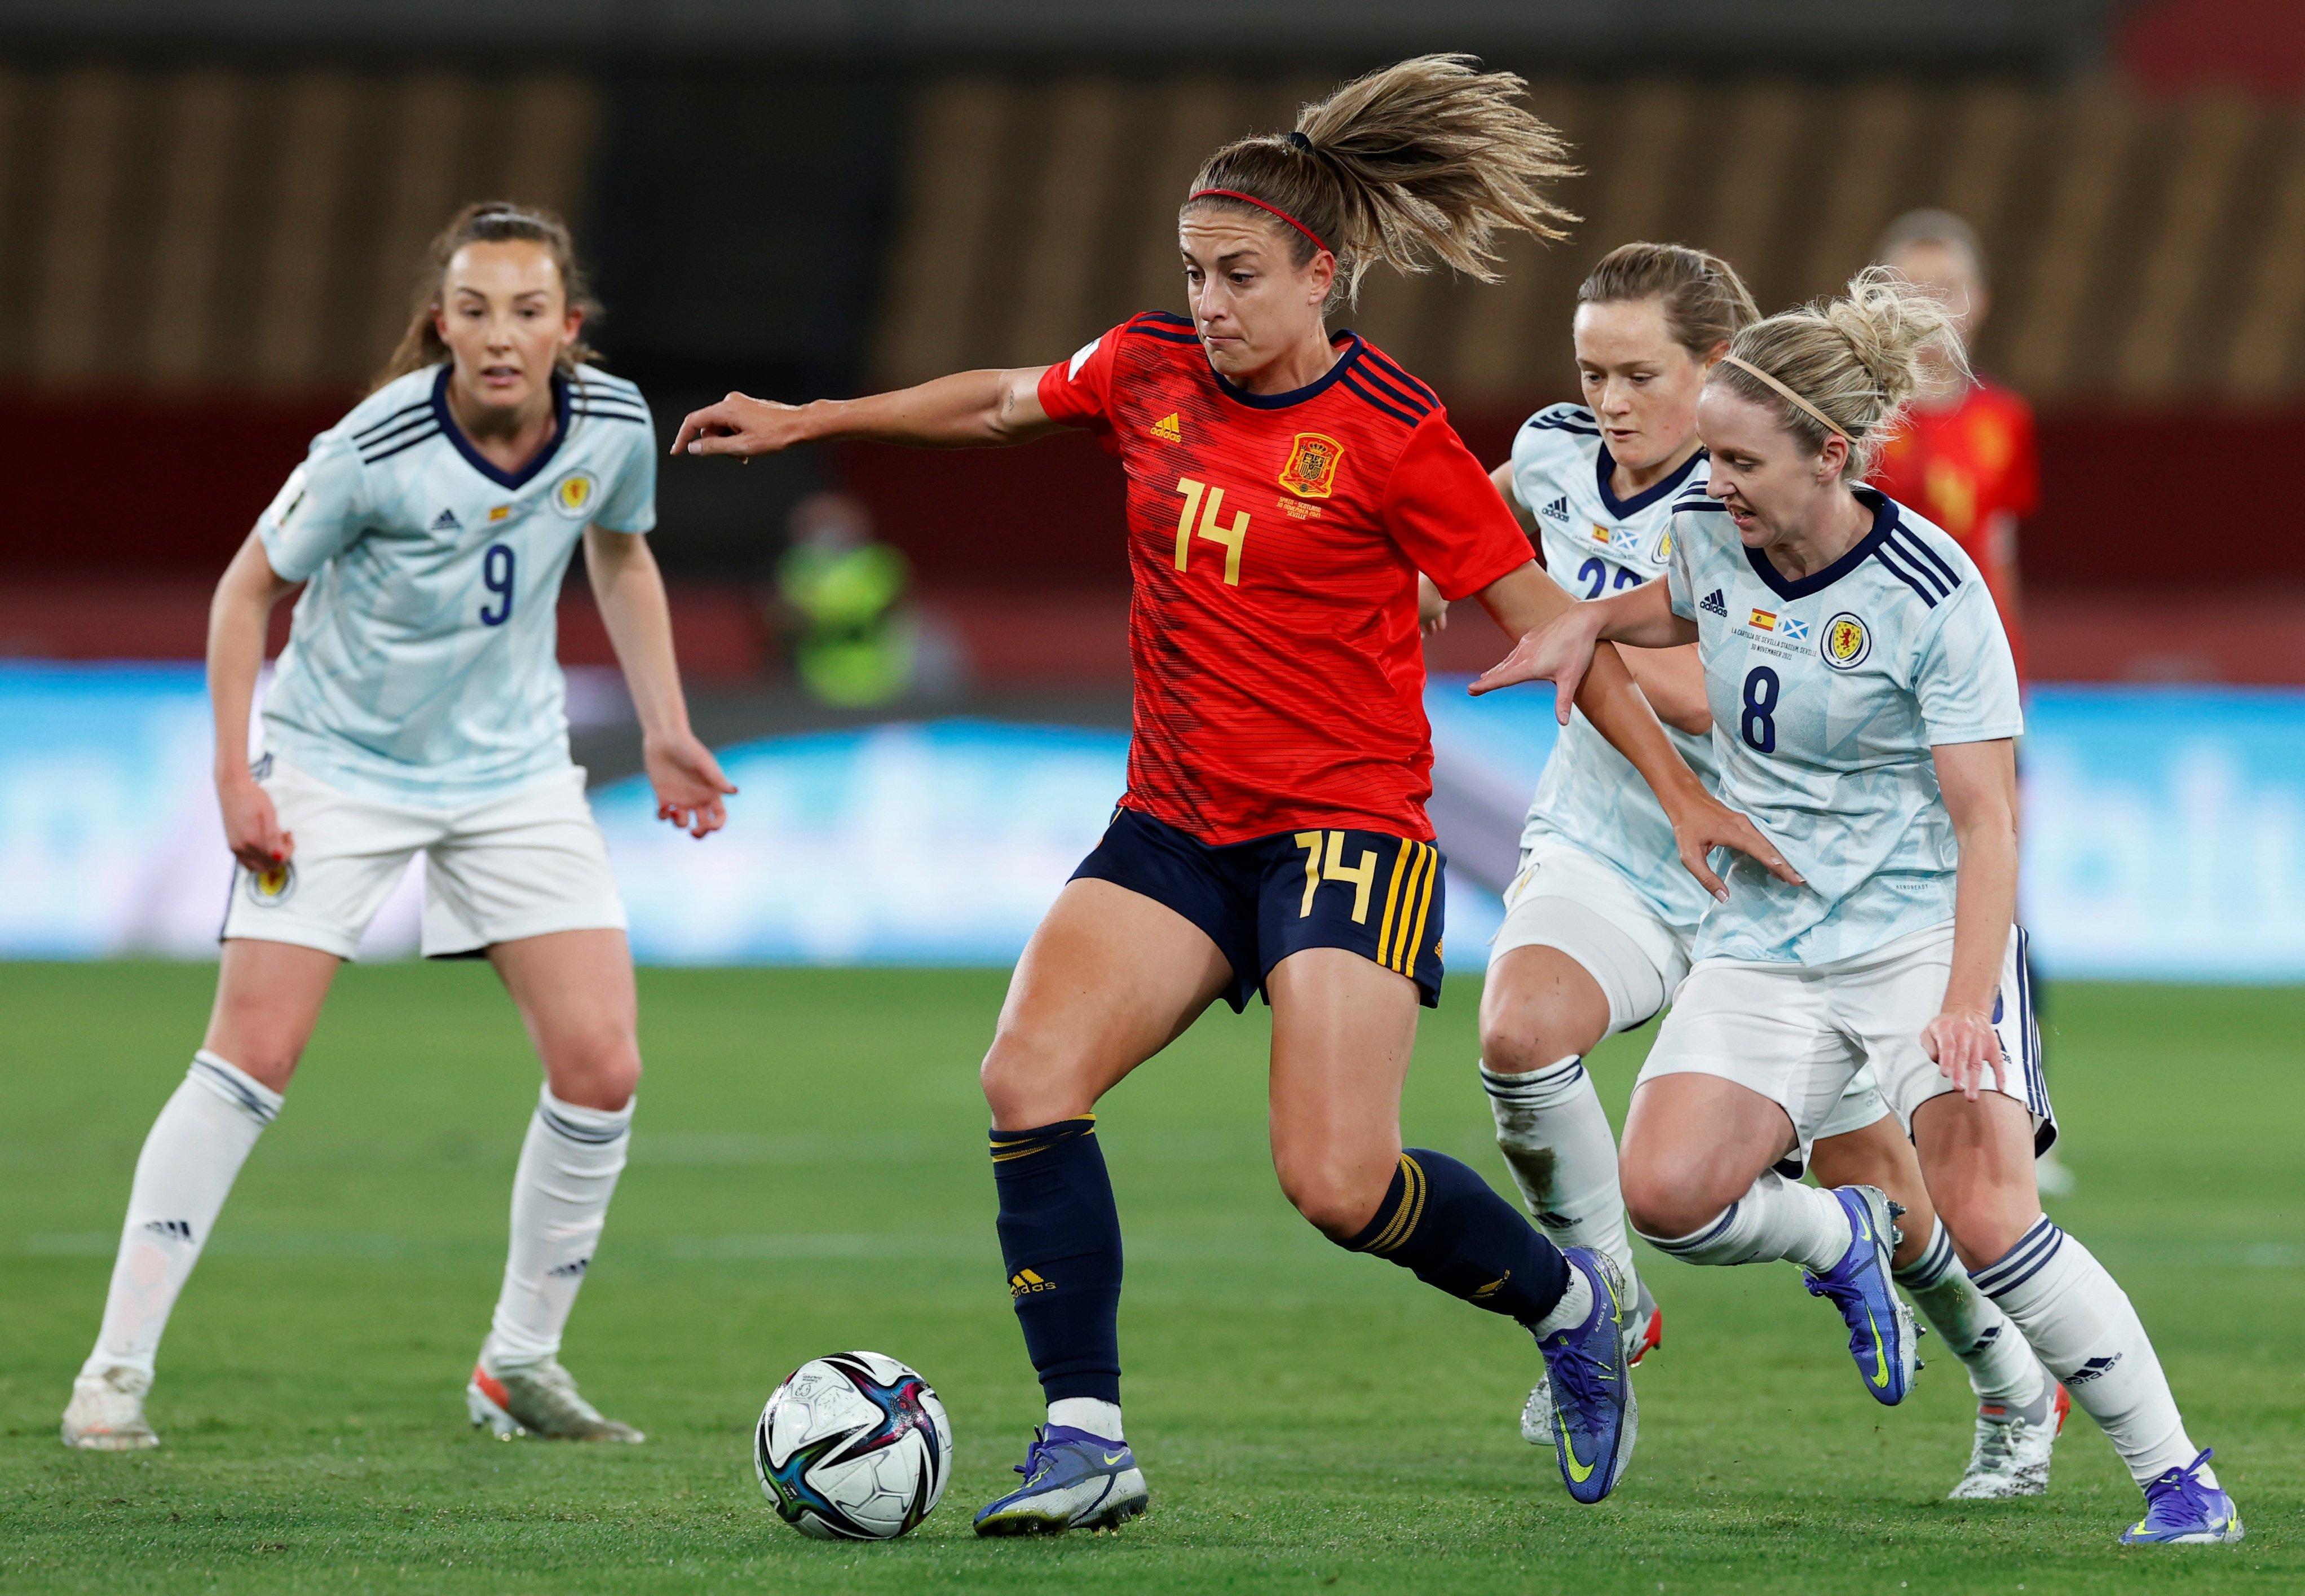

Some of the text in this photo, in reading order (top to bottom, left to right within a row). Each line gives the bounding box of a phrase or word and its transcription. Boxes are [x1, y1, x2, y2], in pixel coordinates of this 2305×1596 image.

[1150, 427, 1182, 443] adidas
[1278, 497, 1294, 505] SPAIN
[1297, 502, 1322, 512] SCOTLAND
[1283, 504, 1308, 515] NOVEMBER
[1286, 510, 1306, 520] SEVILLE
[1542, 507, 1569, 523] adidas
[1174, 477, 1251, 587] 14
[480, 545, 515, 626] 9
[1699, 601, 1728, 617] adidas
[1840, 617, 1861, 627] SCOTLAND
[1737, 629, 1754, 639] CARTUJA
[1761, 636, 1780, 647] SEVILLA
[1800, 647, 1817, 657] SEVILLE
[1782, 652, 1792, 660] 2021
[1741, 666, 1780, 754] 8
[1294, 830, 1377, 925] 14
[1013, 1281, 1057, 1298] didas
[1595, 1311, 1605, 1333] ALEXIA
